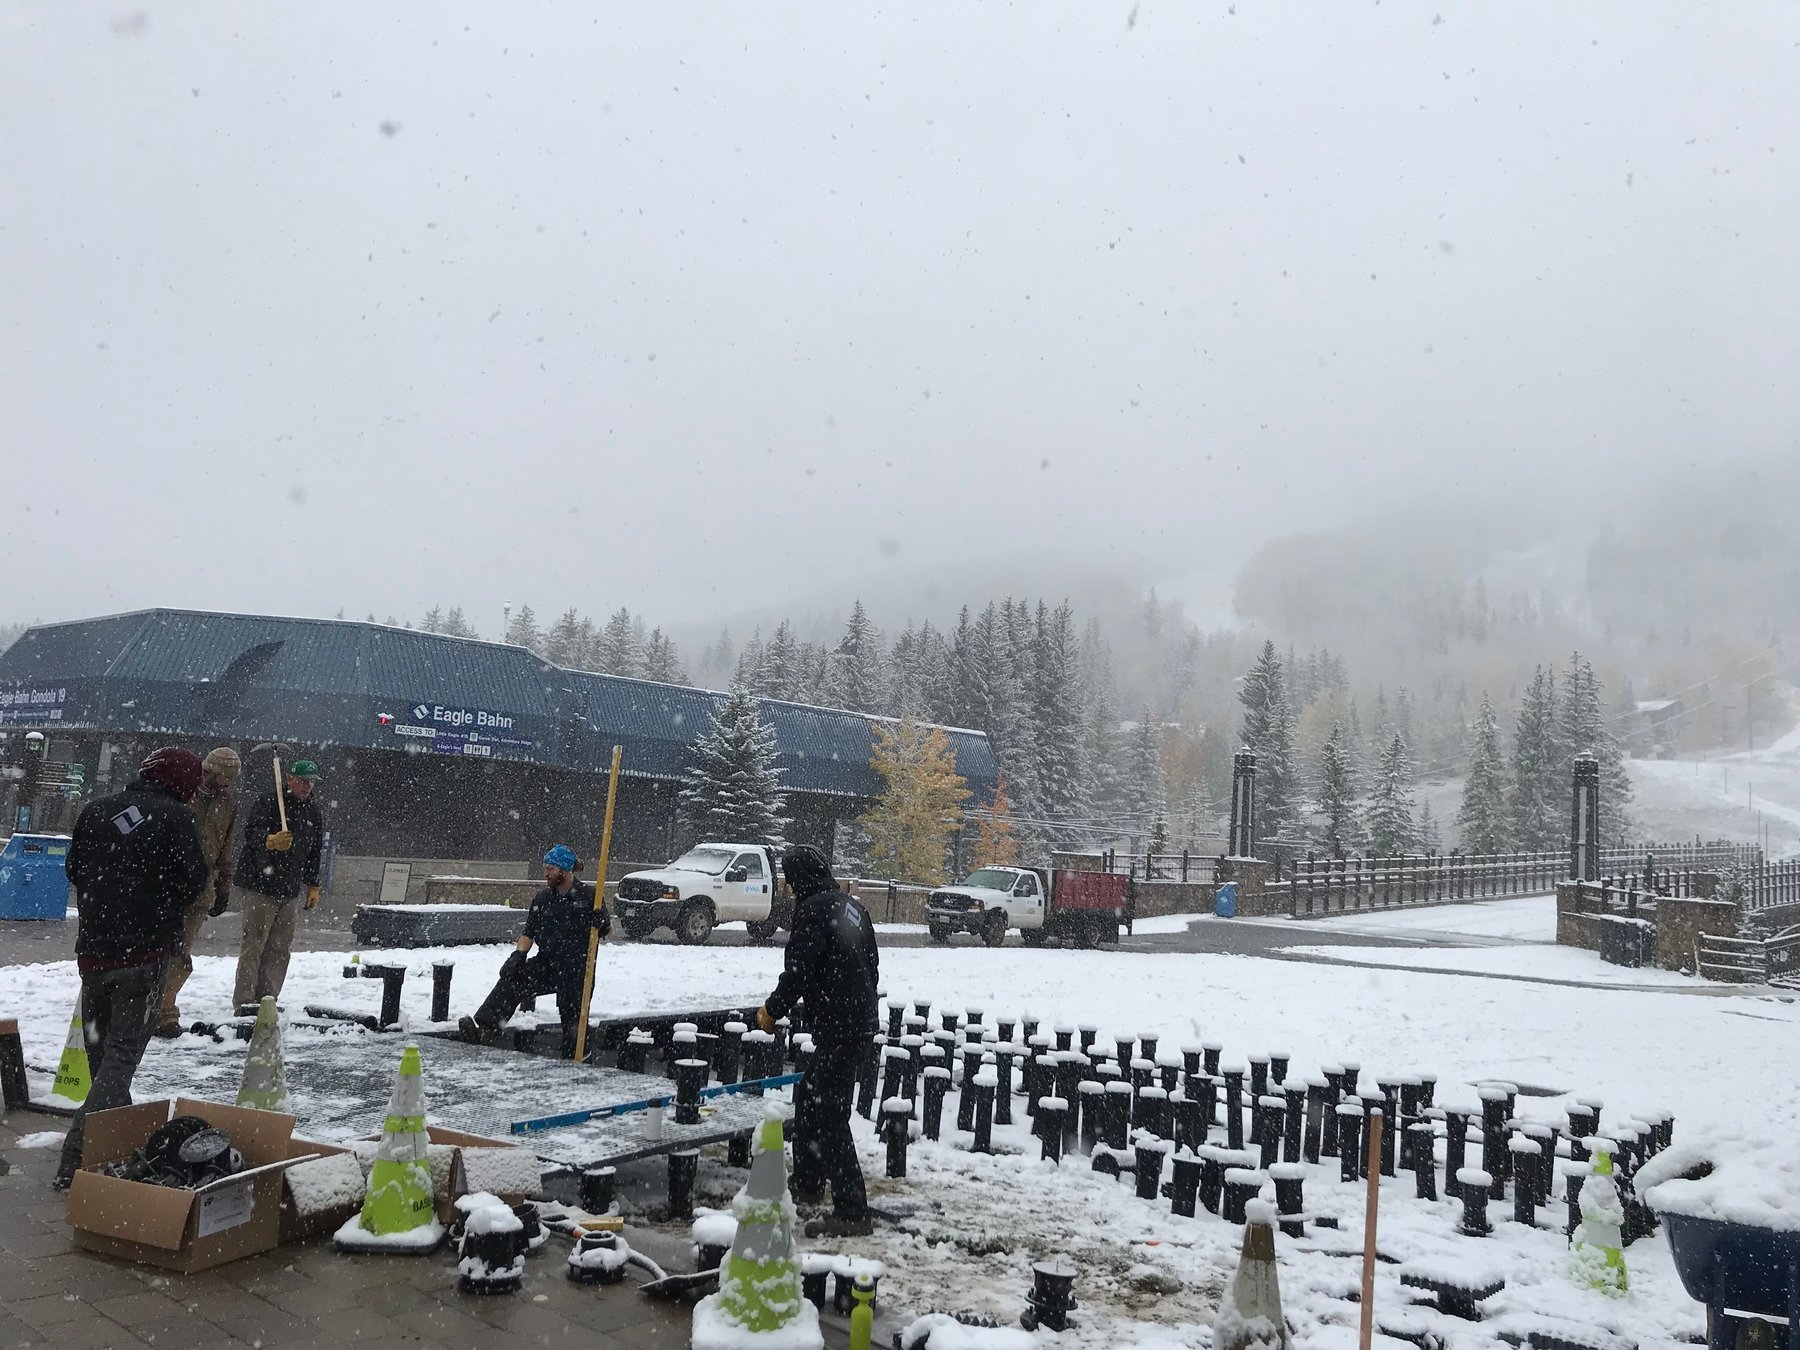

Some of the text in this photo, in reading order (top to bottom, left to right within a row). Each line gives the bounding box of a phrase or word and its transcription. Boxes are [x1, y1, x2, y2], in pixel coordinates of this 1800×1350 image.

[15, 689, 29, 704] Bahn
[31, 689, 56, 704] Gondola
[59, 688, 66, 702] 19
[433, 705, 513, 728] Eagle Bahn
[396, 726, 435, 736] ACCESS TO:
[64, 1076, 80, 1086] OPS
